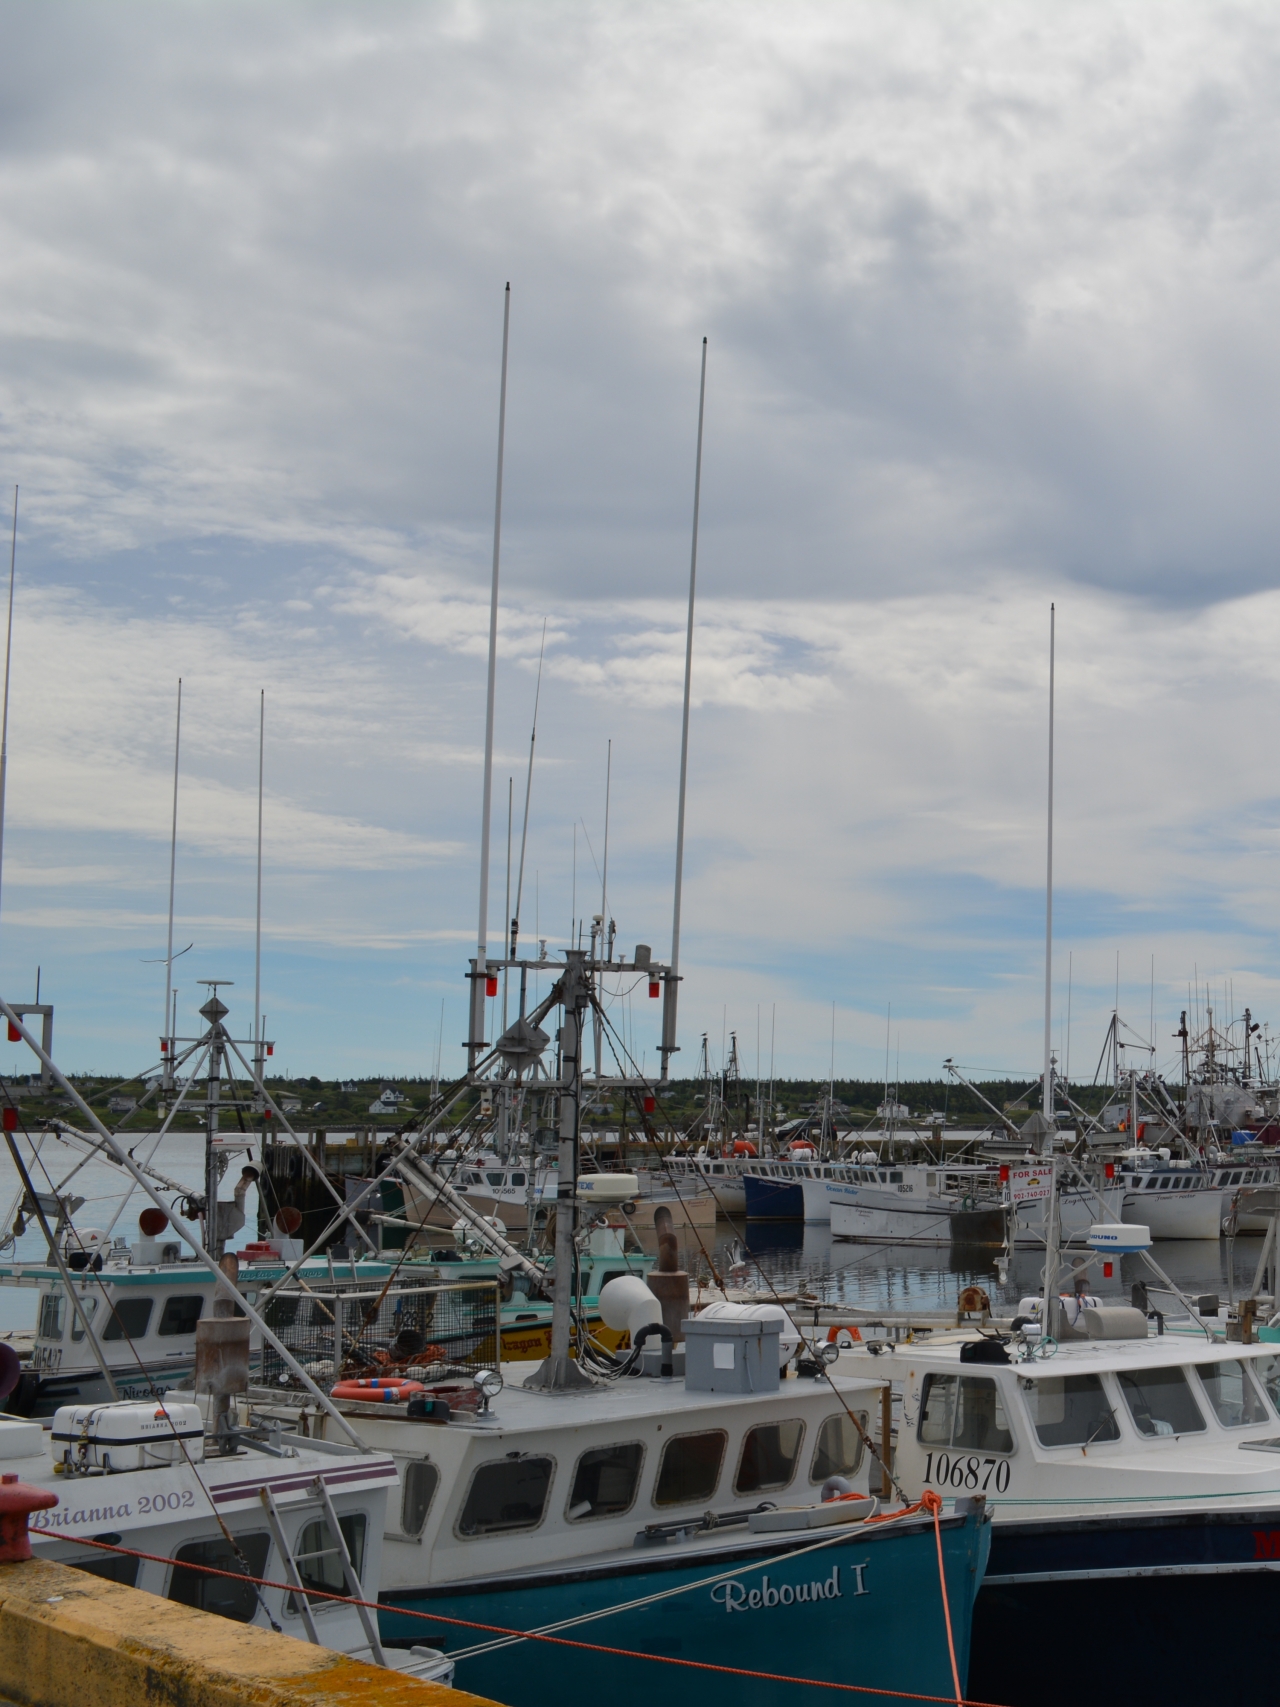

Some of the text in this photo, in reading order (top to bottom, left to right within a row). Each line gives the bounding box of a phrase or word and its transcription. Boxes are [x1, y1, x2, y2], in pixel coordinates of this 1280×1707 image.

[1013, 1168, 1052, 1179] FOR SALE
[825, 1184, 843, 1193] Ocean
[897, 1184, 913, 1193] 105216
[392, 1309, 434, 1328] 10282
[120, 1384, 172, 1401] Nicolas
[922, 1451, 1011, 1494] 106870
[28, 1490, 195, 1529] Brianna 2002
[710, 1563, 870, 1613] Rebound I
